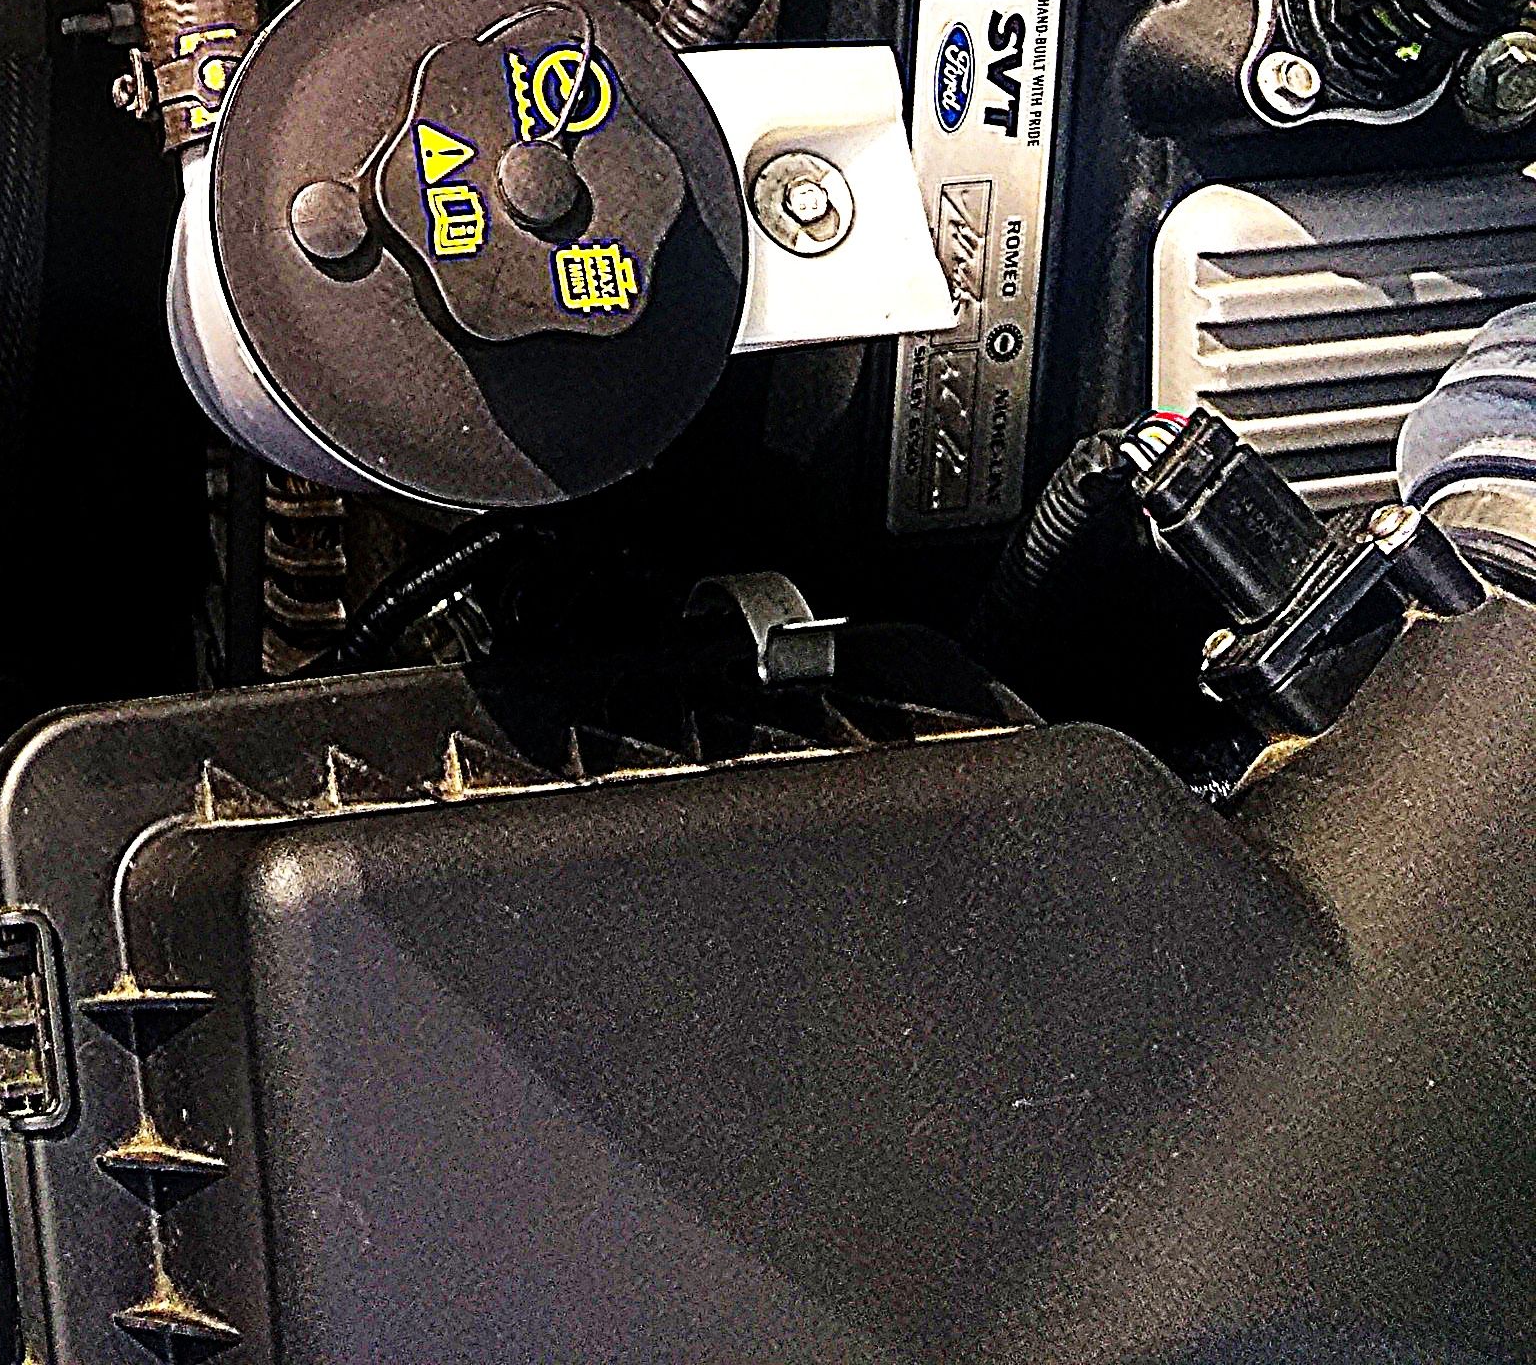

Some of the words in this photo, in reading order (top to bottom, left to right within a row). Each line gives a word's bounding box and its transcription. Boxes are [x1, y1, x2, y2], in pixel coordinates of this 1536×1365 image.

[939, 43, 970, 111] Ford
[983, 10, 1026, 138] SVT
[1030, 76, 1044, 106] WITH
[1026, 110, 1041, 147] PRIDE
[568, 264, 586, 293] MIN
[597, 259, 616, 294] MAX
[1001, 220, 1022, 298] ROMEO
[910, 345, 926, 411] SHELBY
